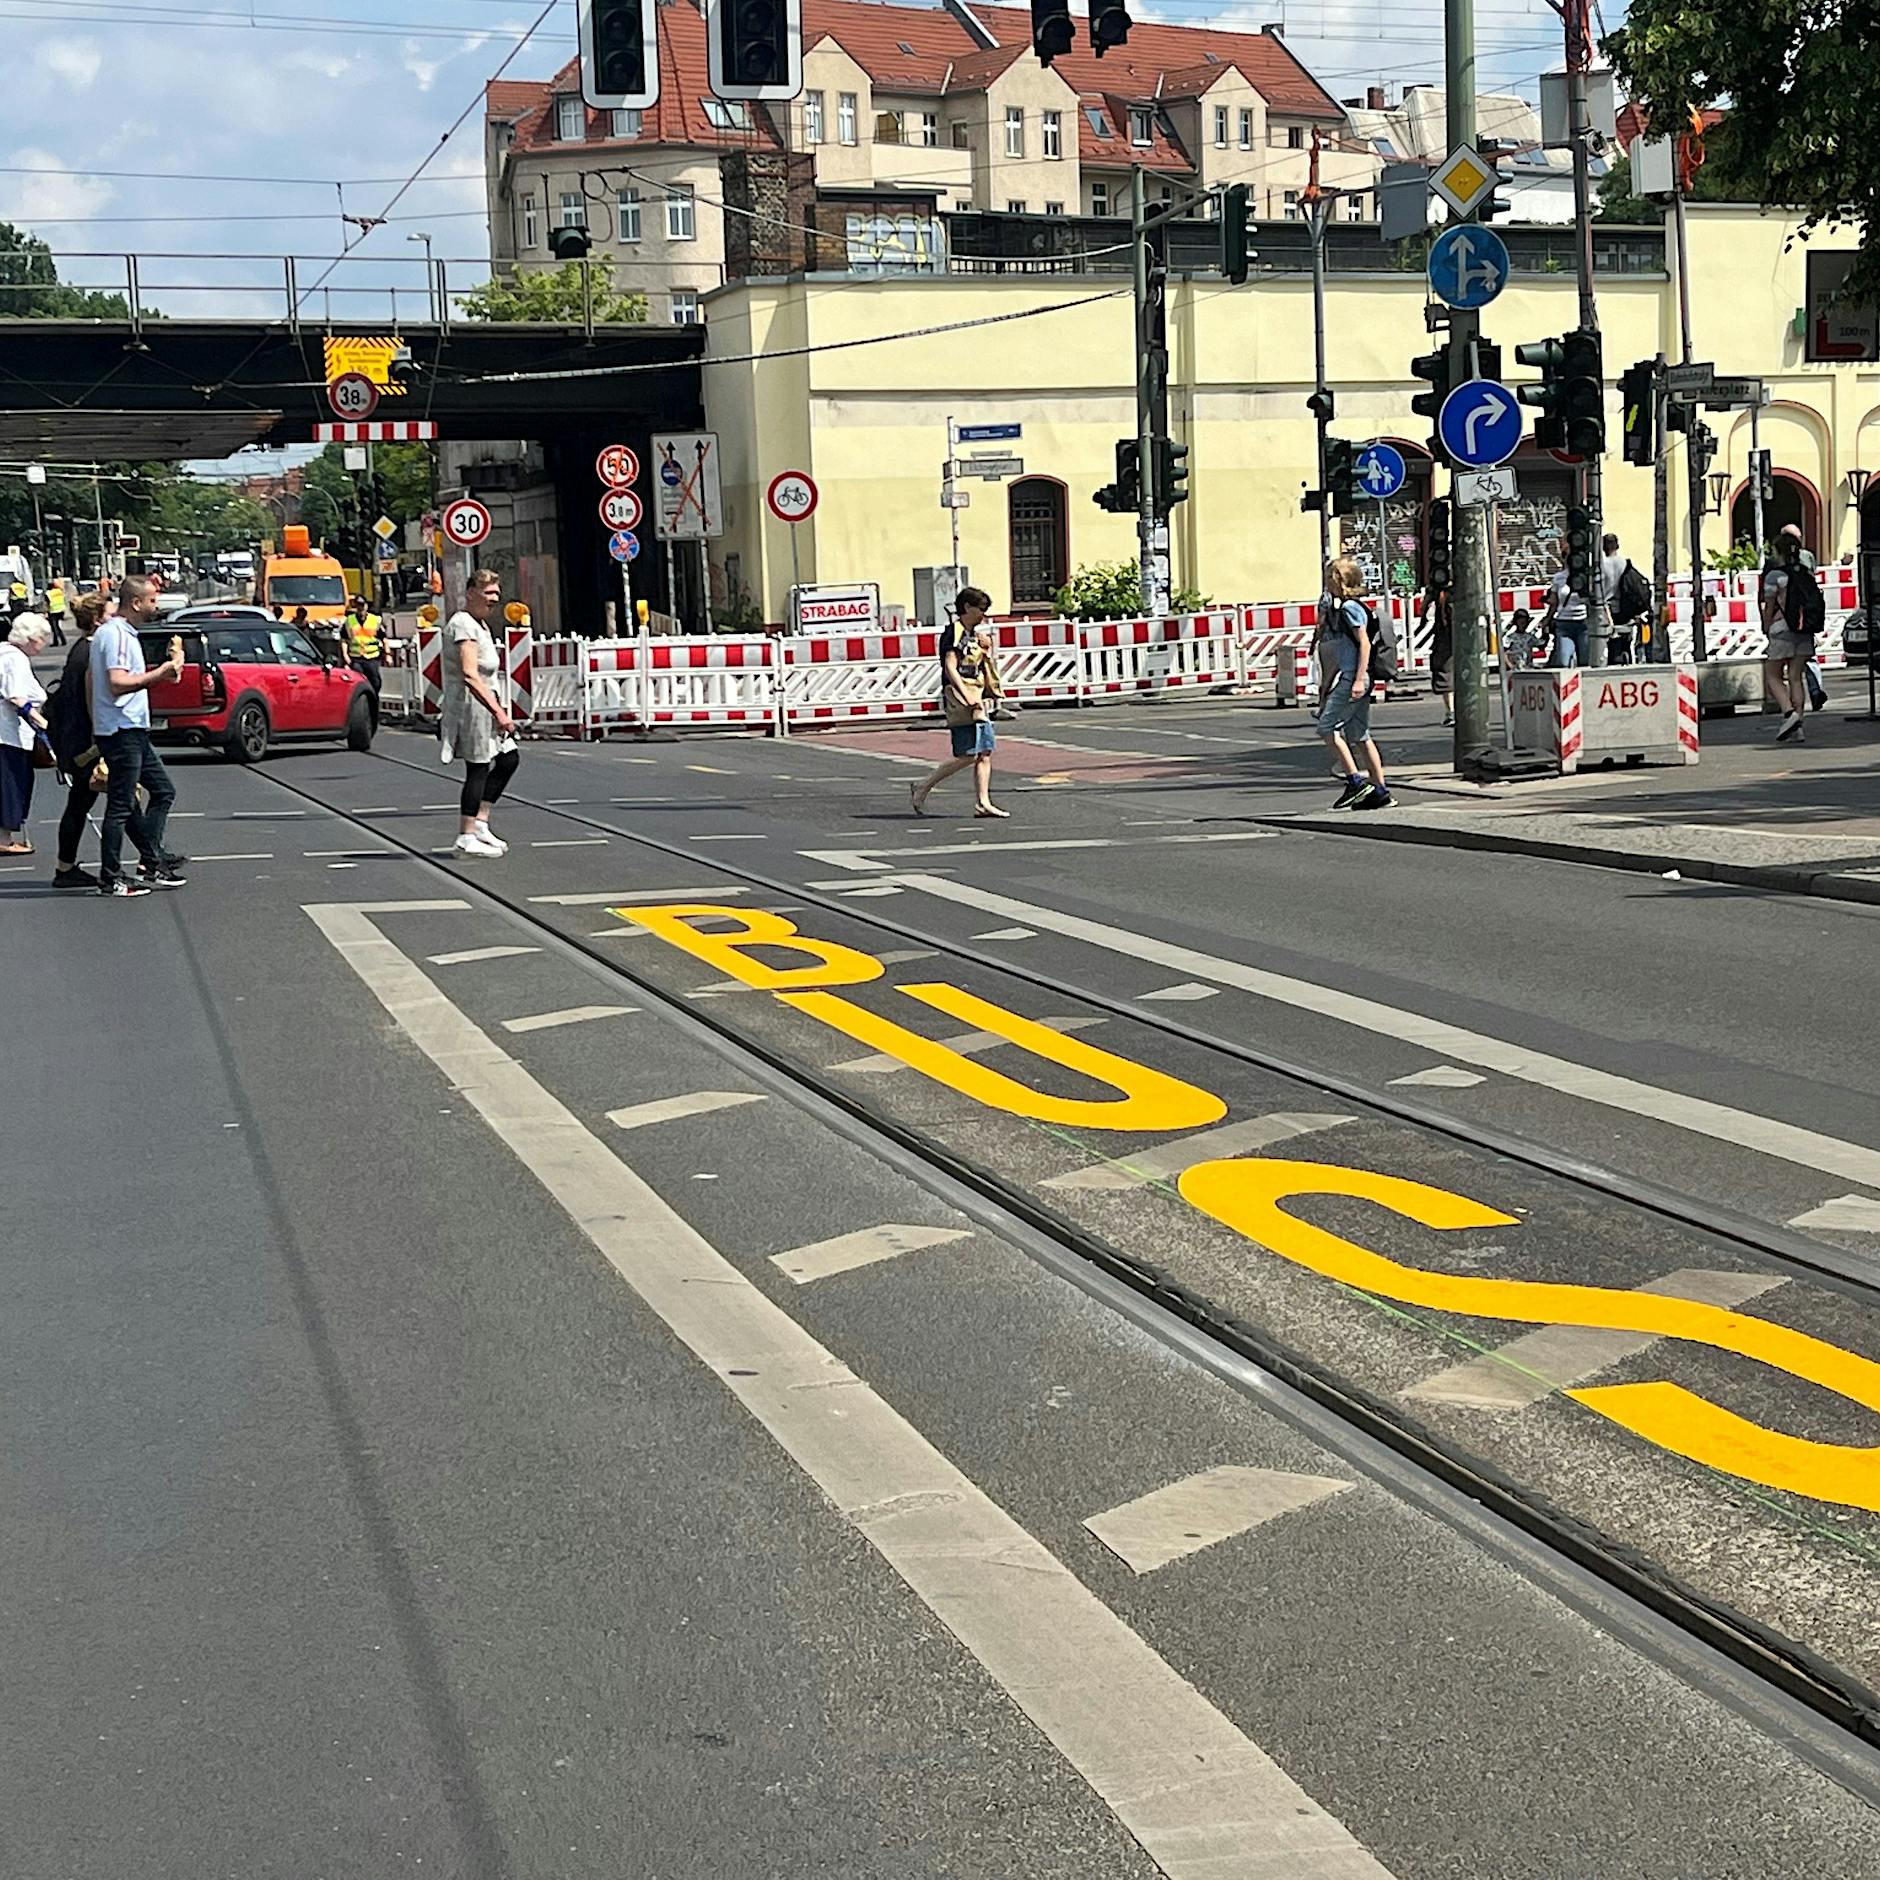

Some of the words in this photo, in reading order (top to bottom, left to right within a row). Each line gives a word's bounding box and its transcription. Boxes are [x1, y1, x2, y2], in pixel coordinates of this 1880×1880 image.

[1840, 327, 1858, 337] 100
[607, 457, 629, 476] 50
[455, 513, 480, 534] 30
[801, 603, 870, 619] STRABAG
[1520, 685, 1545, 711] ABG
[1597, 680, 1659, 709] ABG
